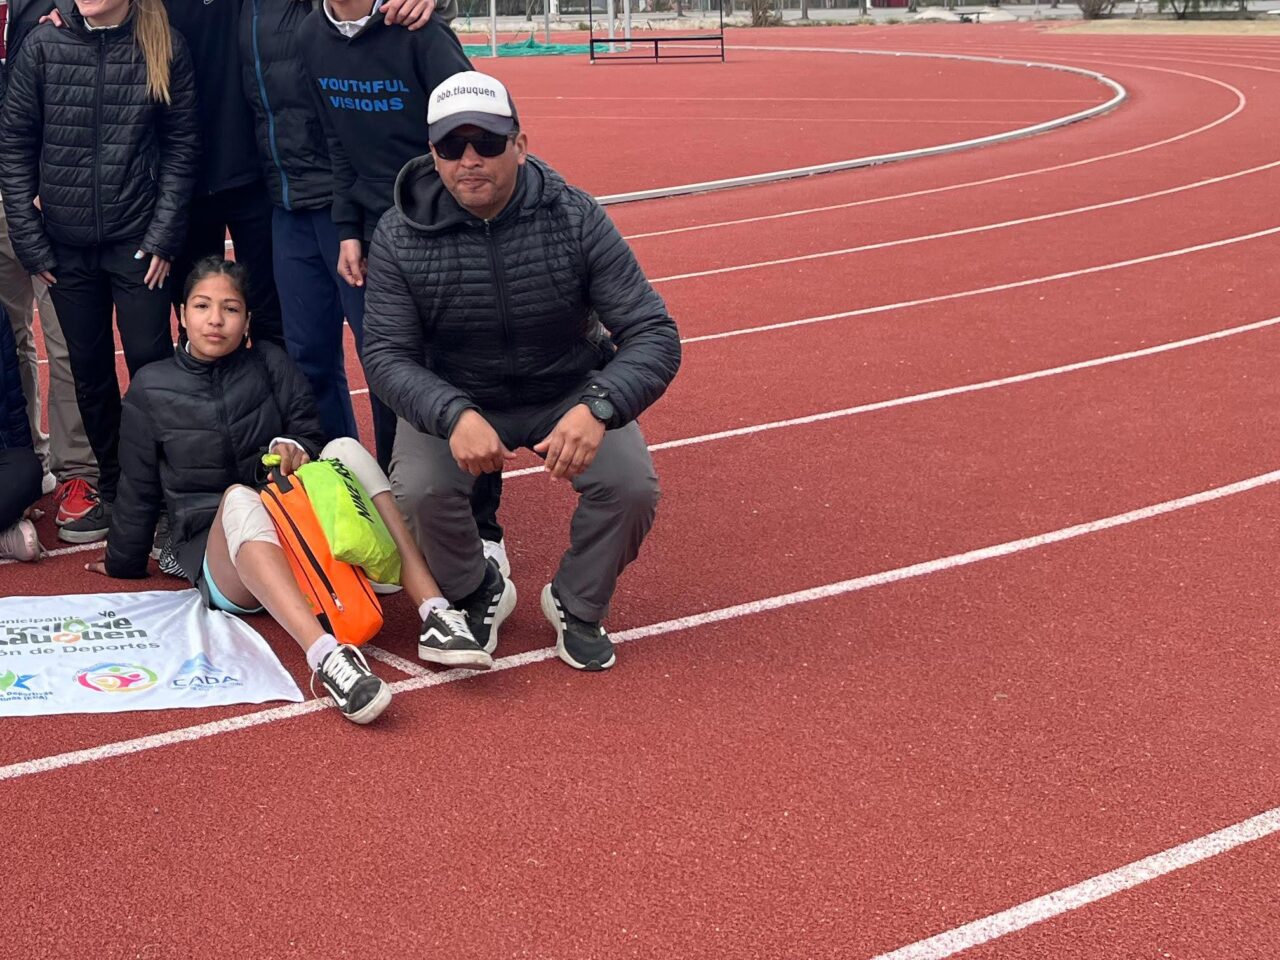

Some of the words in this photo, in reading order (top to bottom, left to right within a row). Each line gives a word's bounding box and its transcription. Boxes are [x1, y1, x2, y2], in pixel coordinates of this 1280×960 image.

[318, 77, 410, 94] YOUTHFUL
[329, 96, 405, 112] VISIONS
[29, 646, 55, 655] de
[63, 641, 161, 654] Deportes
[173, 675, 239, 687] CADA
